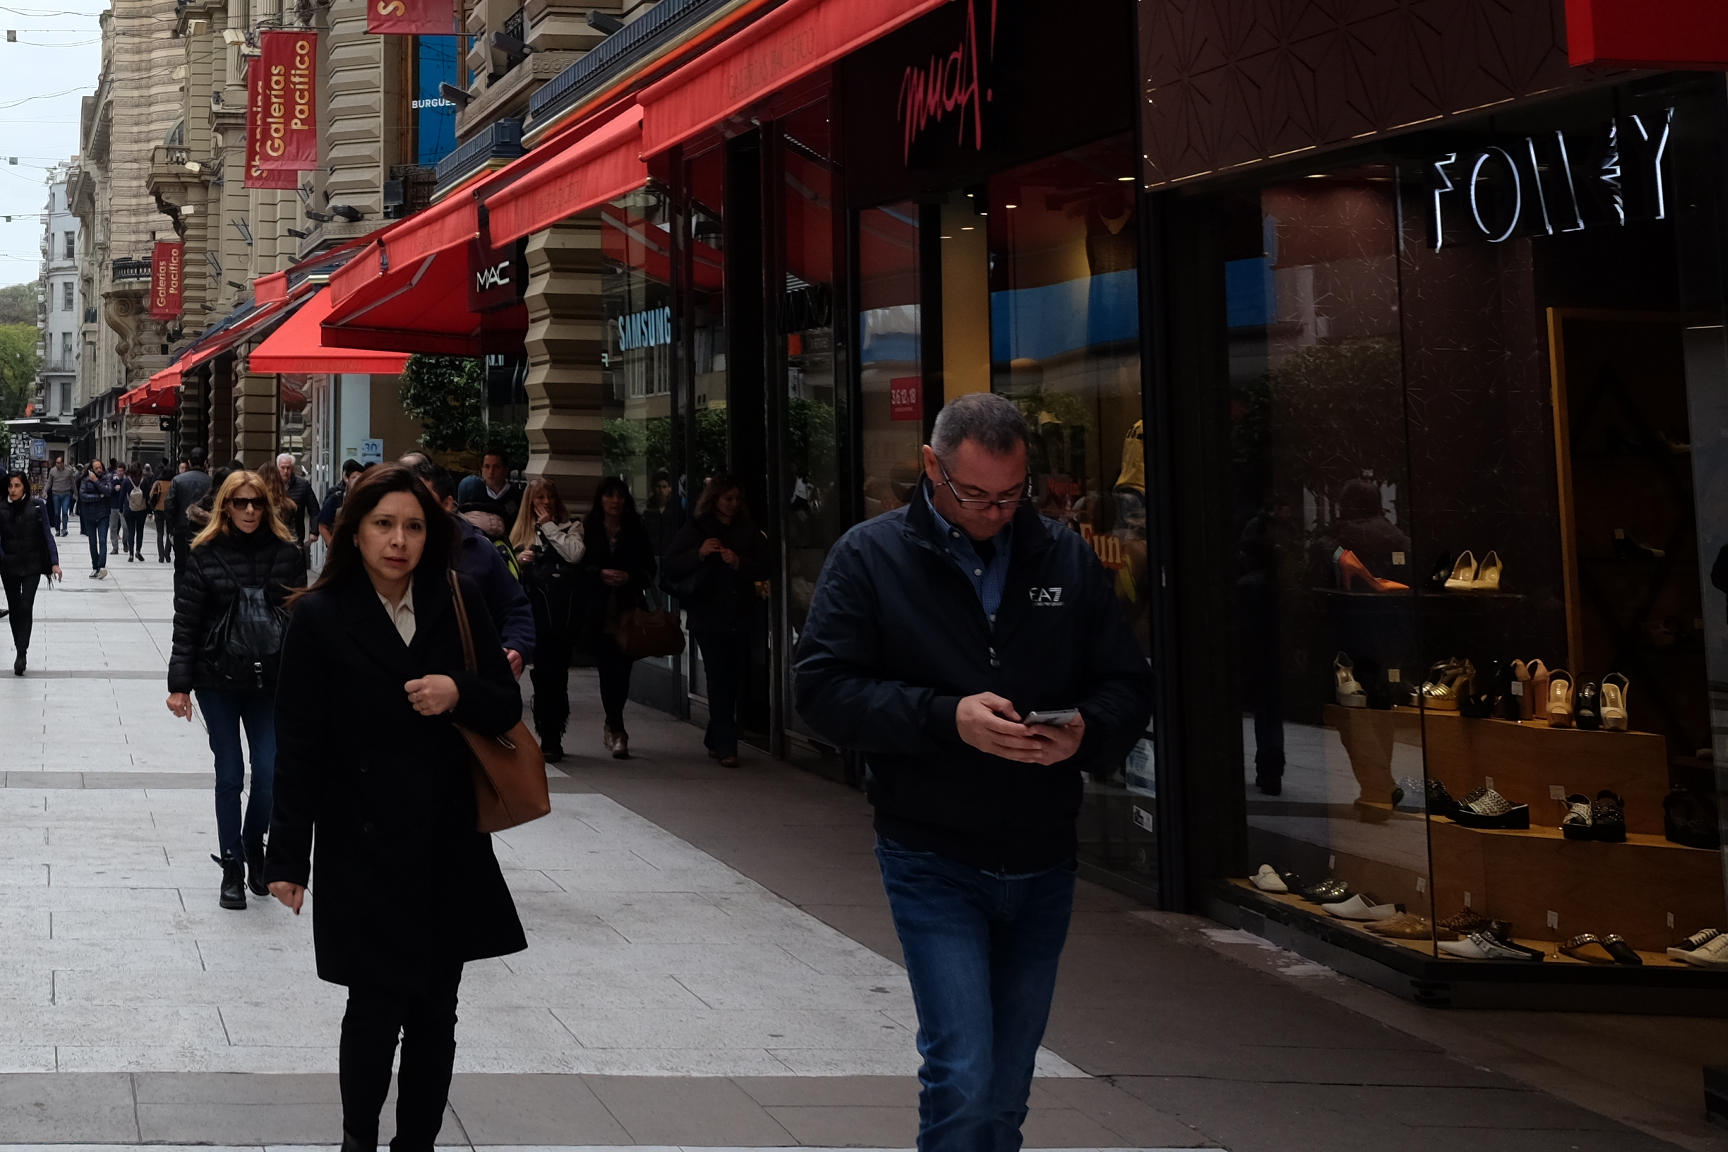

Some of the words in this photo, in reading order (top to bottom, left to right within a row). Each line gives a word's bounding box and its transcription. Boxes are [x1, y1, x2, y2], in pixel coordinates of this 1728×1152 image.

[289, 39, 311, 131] Pacífico
[265, 64, 286, 157] Galerías
[156, 260, 167, 307] Galerías
[168, 248, 179, 294] Pacífico
[476, 260, 510, 293] MAC
[618, 306, 671, 352] SAMSUNG
[1028, 586, 1063, 602] EA7
